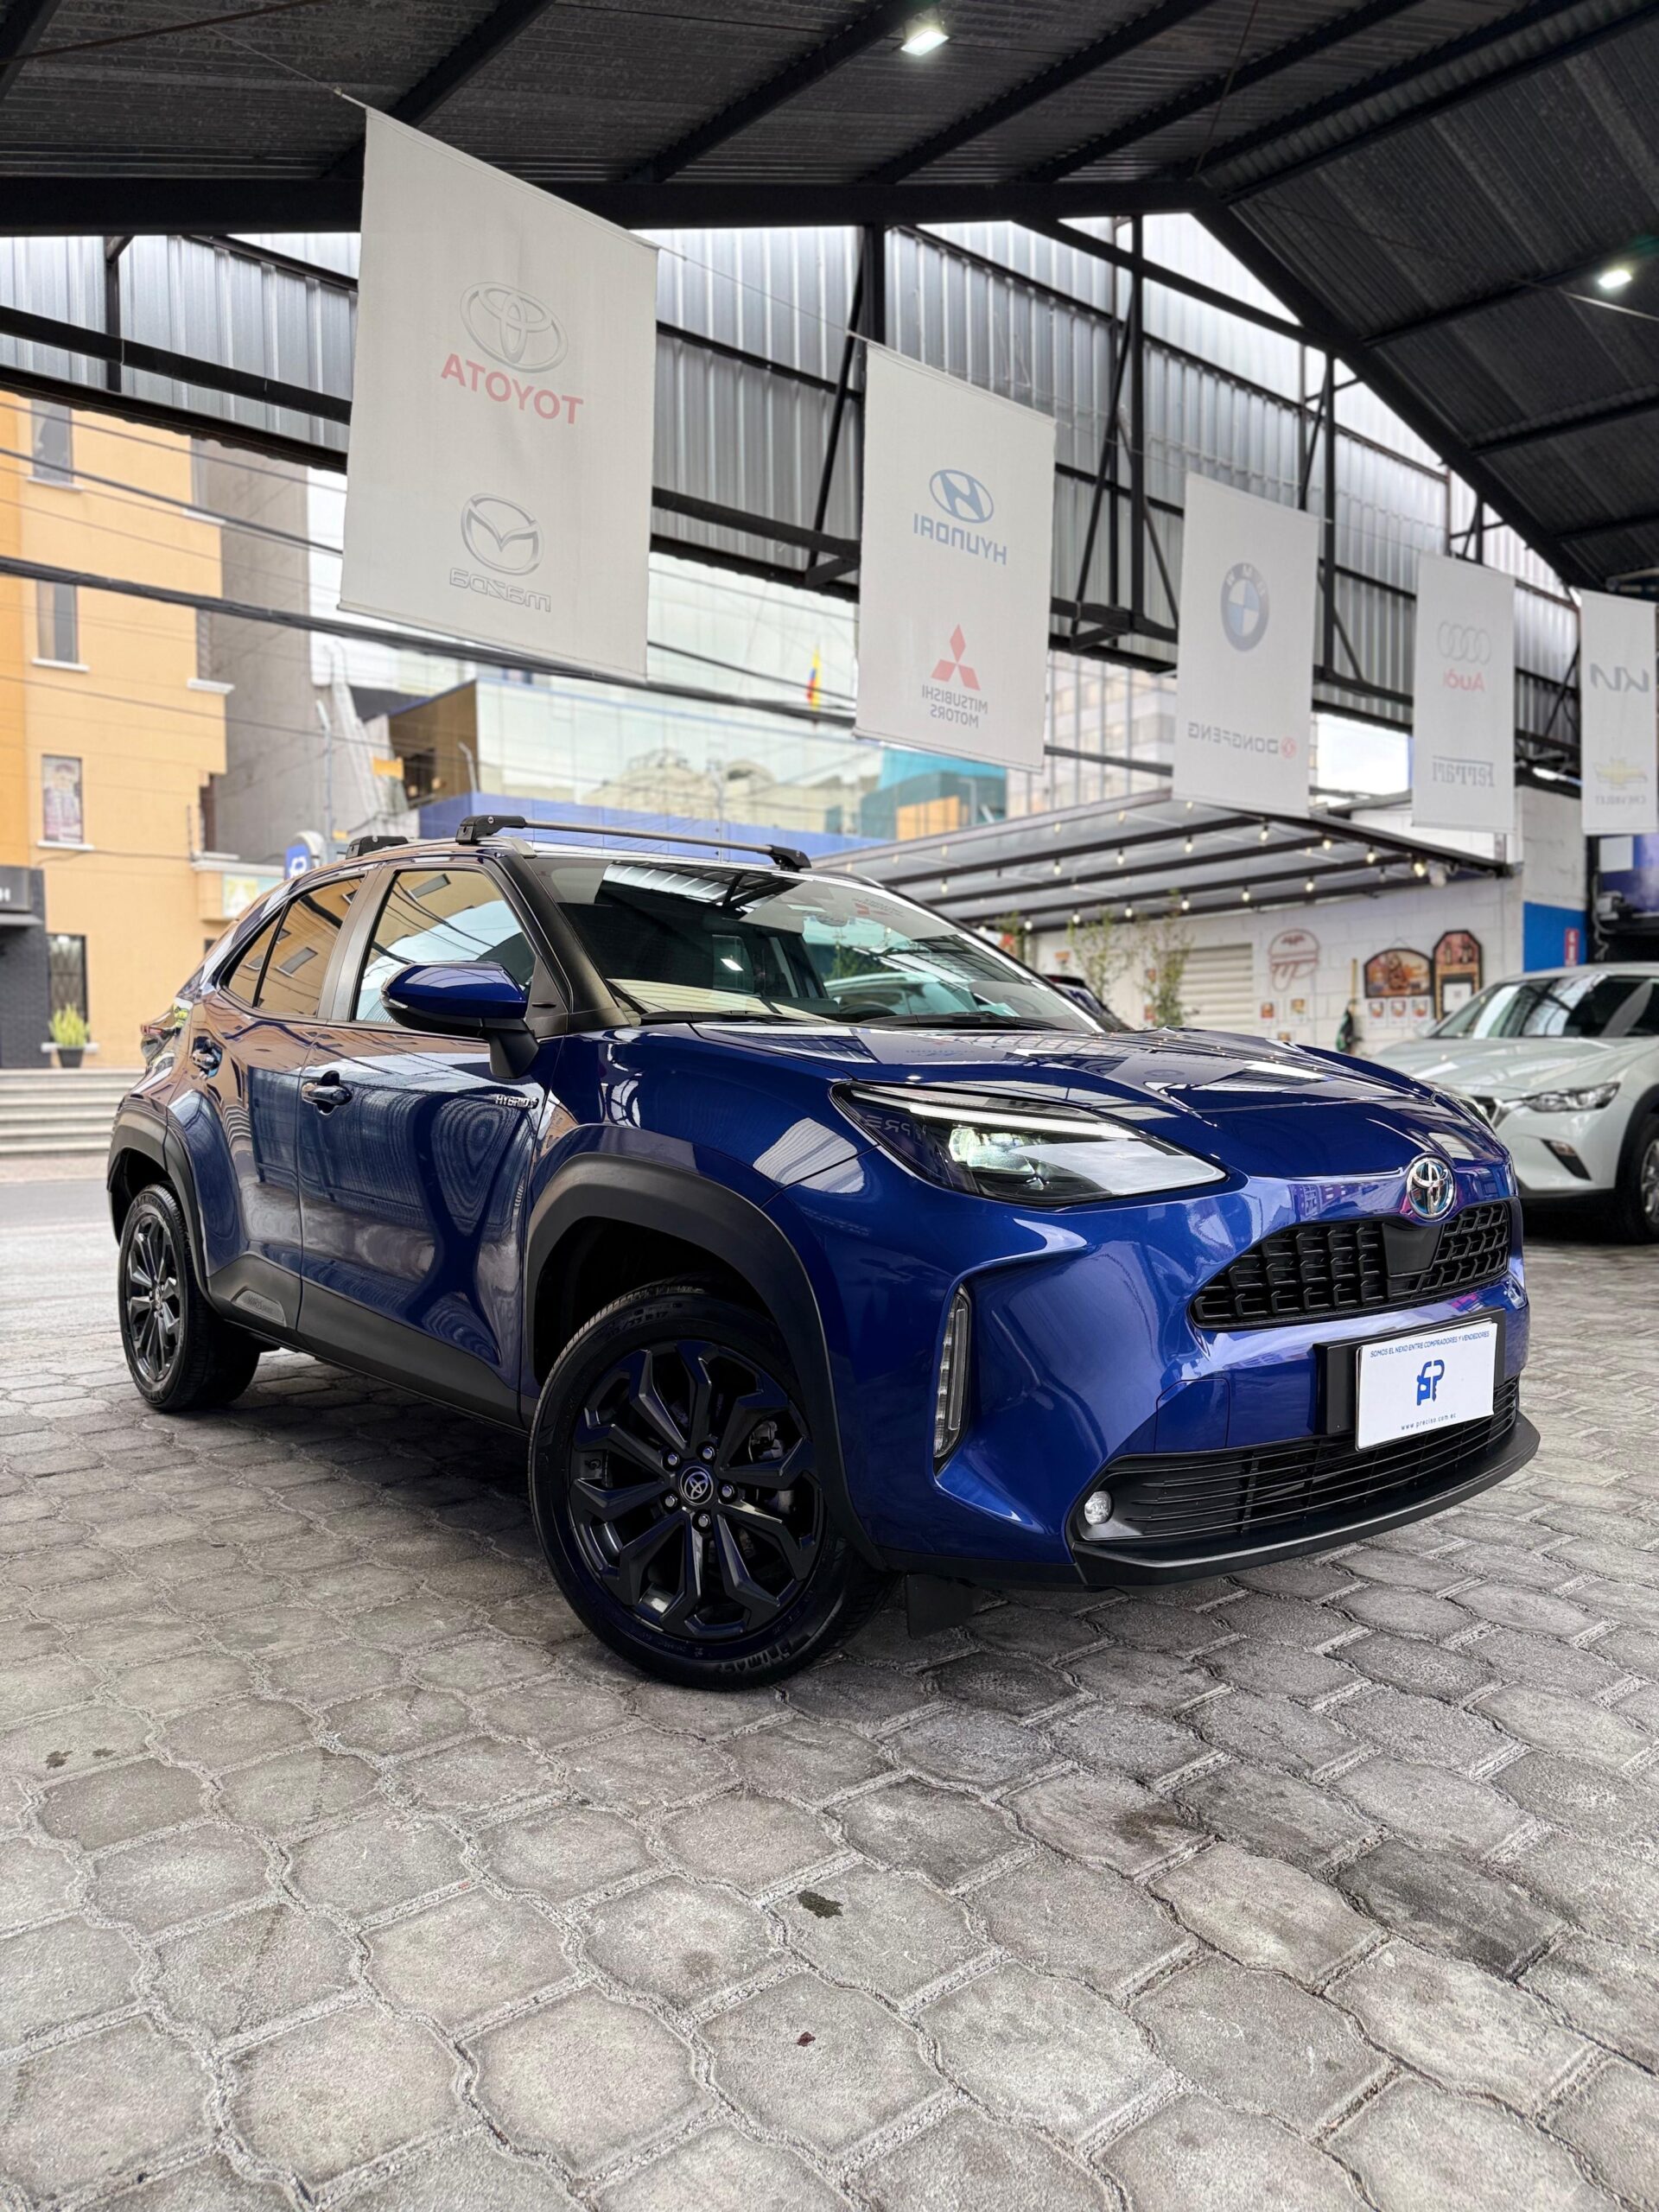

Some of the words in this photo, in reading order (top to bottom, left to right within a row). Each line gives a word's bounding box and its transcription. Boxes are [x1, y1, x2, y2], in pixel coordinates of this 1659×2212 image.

[1370, 1348, 1389, 1357] SOMOS
[1395, 1344, 1408, 1353] NEXO
[1408, 1342, 1424, 1351] ENTRE
[1424, 1335, 1458, 1349] COMPRADORES
[1462, 1331, 1490, 1342] VENDEDORES
